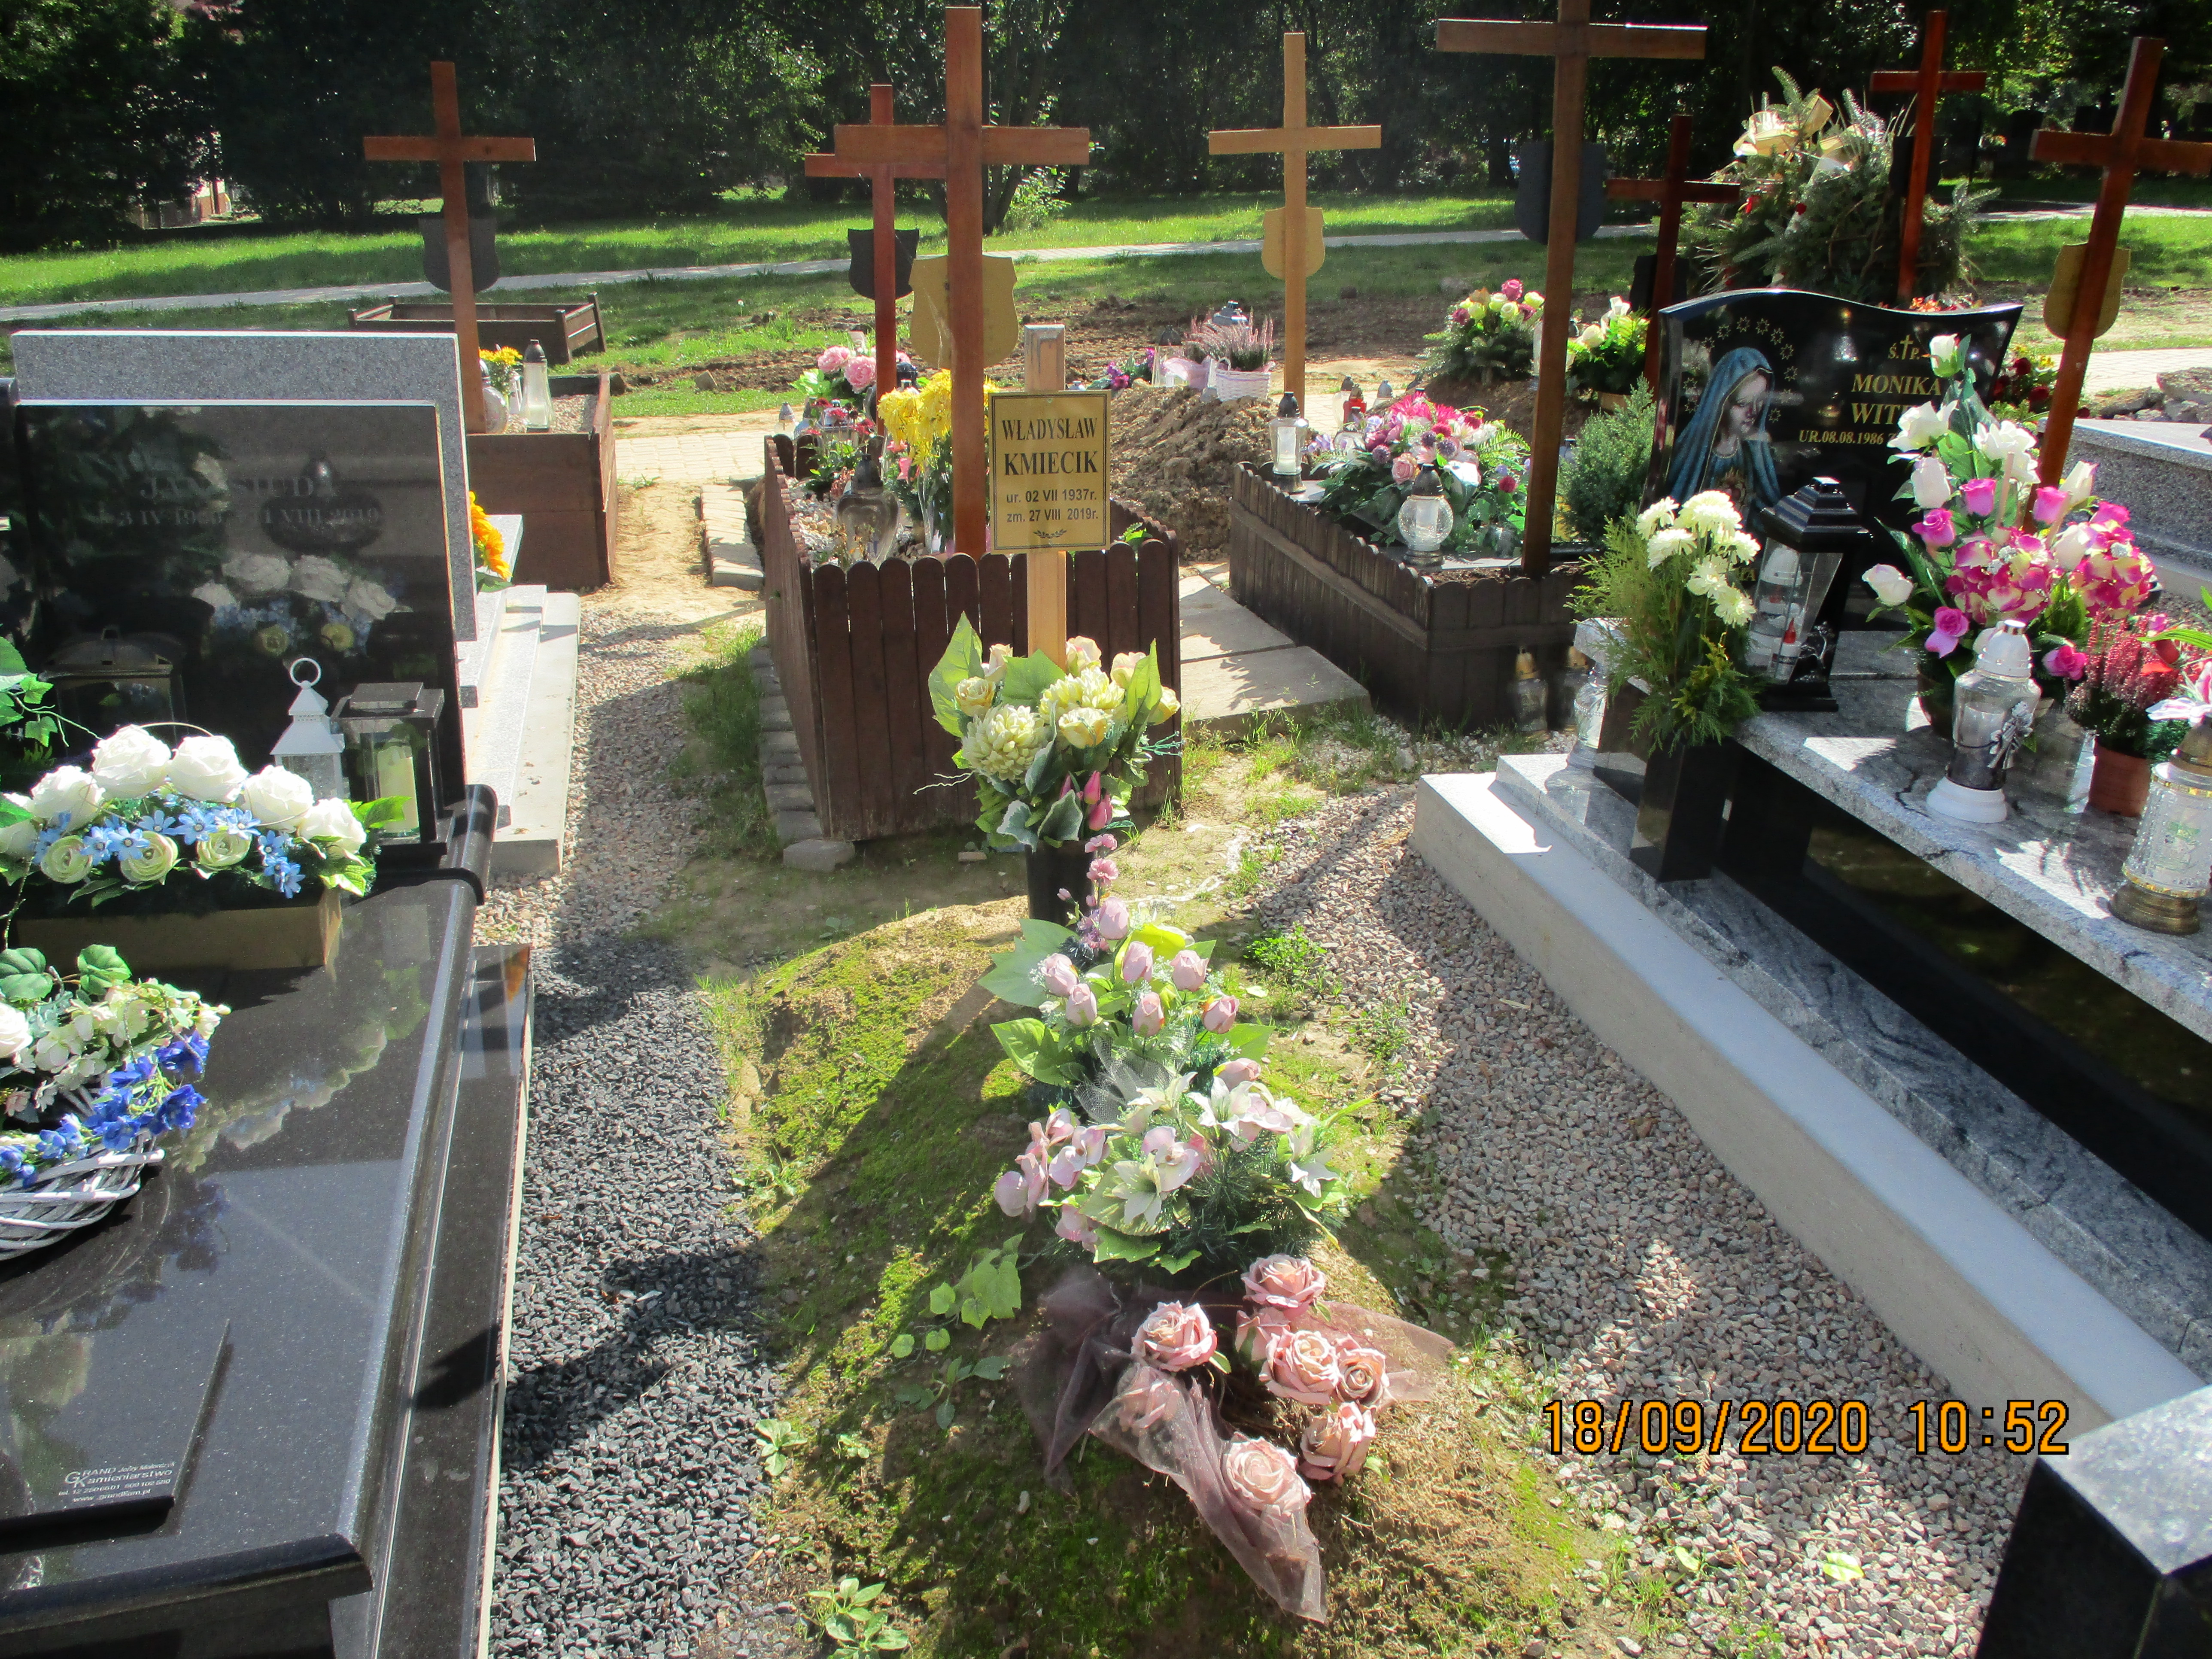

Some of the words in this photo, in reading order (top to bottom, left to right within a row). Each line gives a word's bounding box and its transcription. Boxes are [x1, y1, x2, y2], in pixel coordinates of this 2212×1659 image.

[1850, 374, 1941, 395] MONIKA
[1851, 402, 1909, 424] WIT
[1002, 418, 1097, 441] WŁADYSŁAW
[1004, 451, 1099, 475] KMIECIK
[1006, 493, 1021, 503] ur.
[1025, 490, 1039, 502] 02
[1043, 489, 1057, 501] VII
[1062, 488, 1097, 501] 1937r.
[1007, 513, 1025, 523] zm.
[1029, 509, 1041, 521] 27
[1044, 509, 1060, 521] VIII
[1067, 507, 1098, 520] 2019r.
[65, 1467, 116, 1483] GRAND
[73, 1470, 173, 1488] Kamieniarstwo
